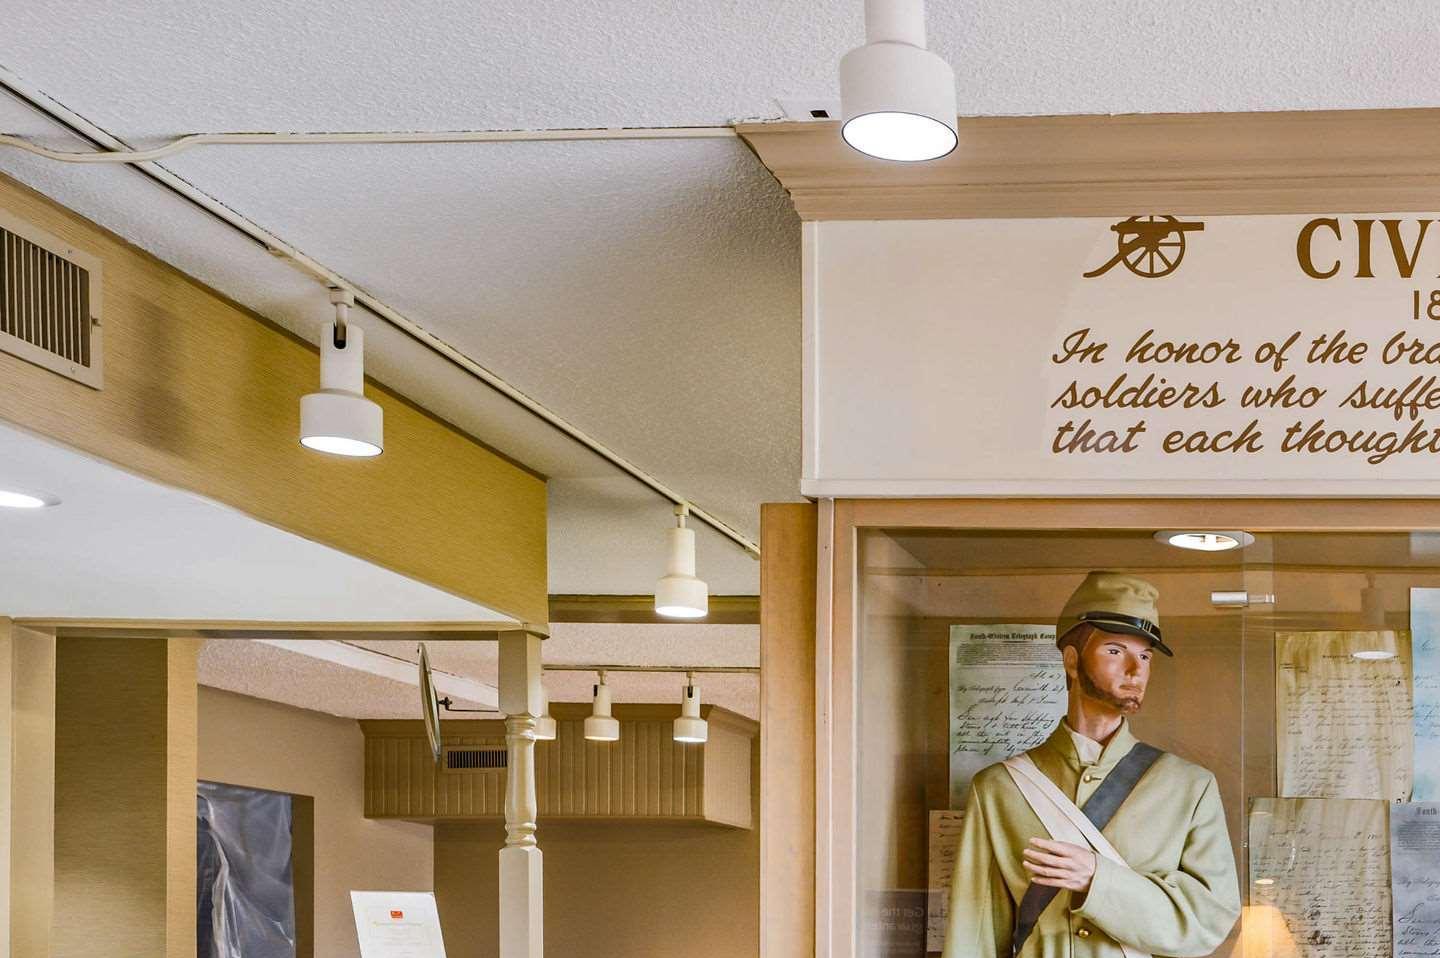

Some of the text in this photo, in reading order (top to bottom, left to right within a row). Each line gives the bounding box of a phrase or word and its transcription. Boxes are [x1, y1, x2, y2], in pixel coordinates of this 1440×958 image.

[1051, 328, 1109, 365] In
[1124, 329, 1243, 364] honor
[1254, 330, 1301, 373] of
[1306, 329, 1369, 365] the
[1050, 373, 1227, 410] soldiers
[1240, 373, 1328, 409] who
[1051, 419, 1147, 455] that
[1162, 419, 1265, 454] each
